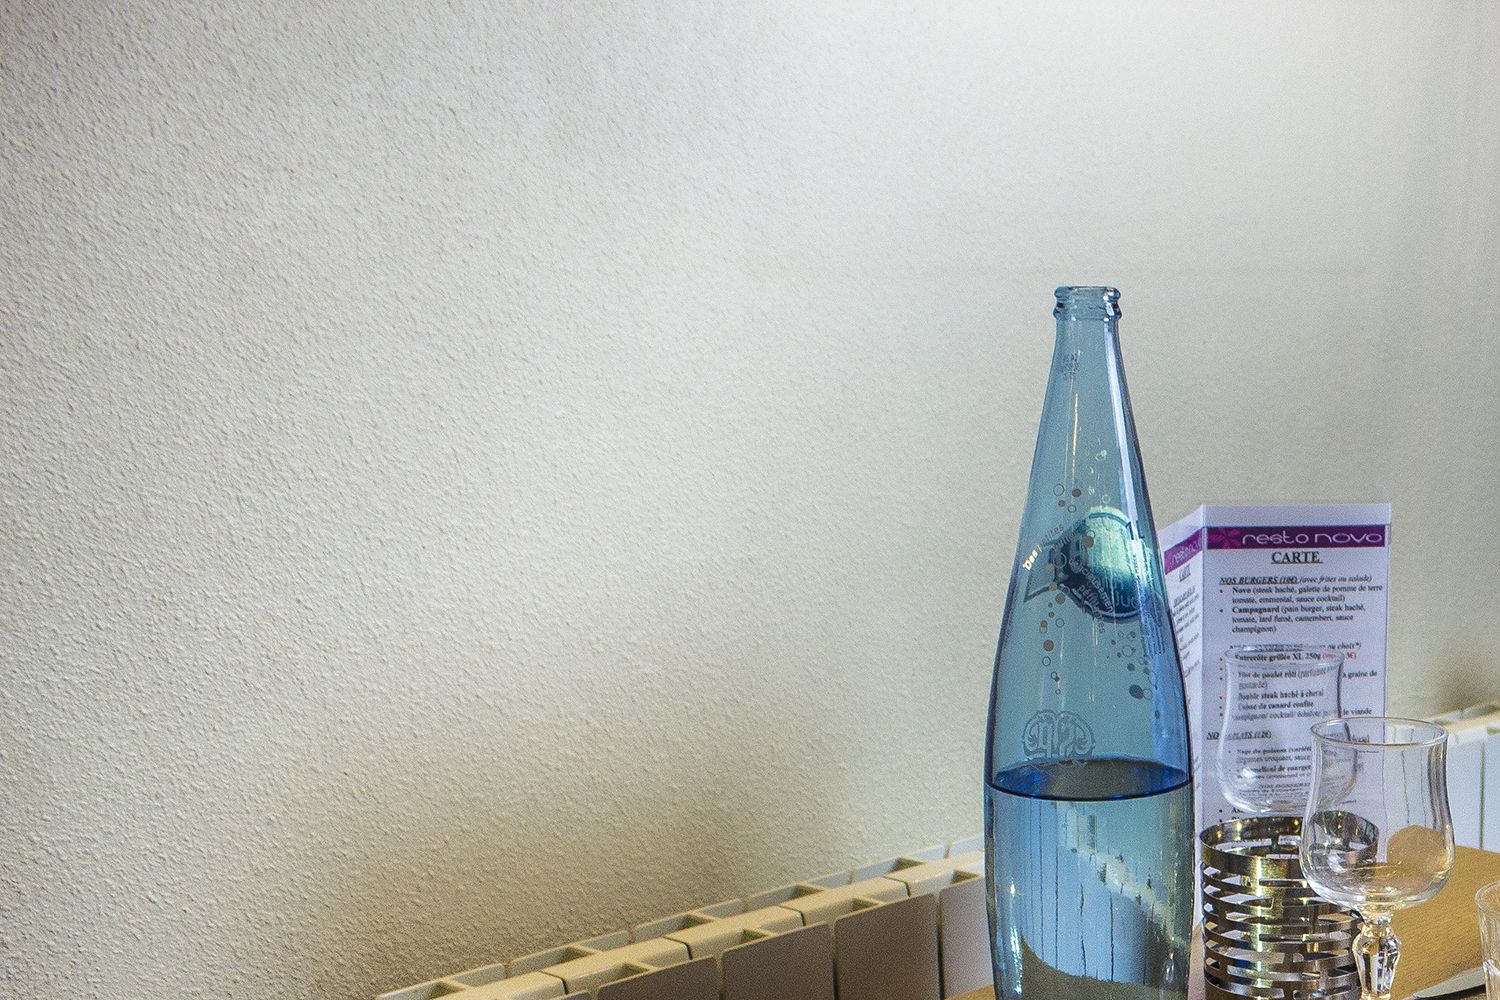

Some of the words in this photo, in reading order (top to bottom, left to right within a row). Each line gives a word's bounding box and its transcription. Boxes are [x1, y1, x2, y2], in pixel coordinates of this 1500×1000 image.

[1242, 530, 1309, 546] resto
[1314, 531, 1383, 545] novo
[1271, 552, 1320, 564] CARTE
[1219, 577, 1237, 585] NOS
[1237, 576, 1279, 585] BURGERS
[1318, 575, 1338, 585] frites
[1253, 586, 1273, 595] (steak
[1298, 585, 1321, 596] galette
[1322, 585, 1331, 593] de
[1332, 587, 1357, 596] pomme
[1358, 584, 1367, 592] de
[1232, 606, 1280, 615] Campagnard
[1281, 605, 1299, 615] (pain
[1300, 605, 1324, 614] burger,
[1325, 604, 1343, 612] steak
[1258, 614, 1273, 623] lard
[1232, 625, 1277, 635] champignon)
[1347, 669, 1368, 679] graine
[1368, 669, 1378, 677] de
[1350, 708, 1372, 716] viande
[1206, 731, 1221, 741] NO
